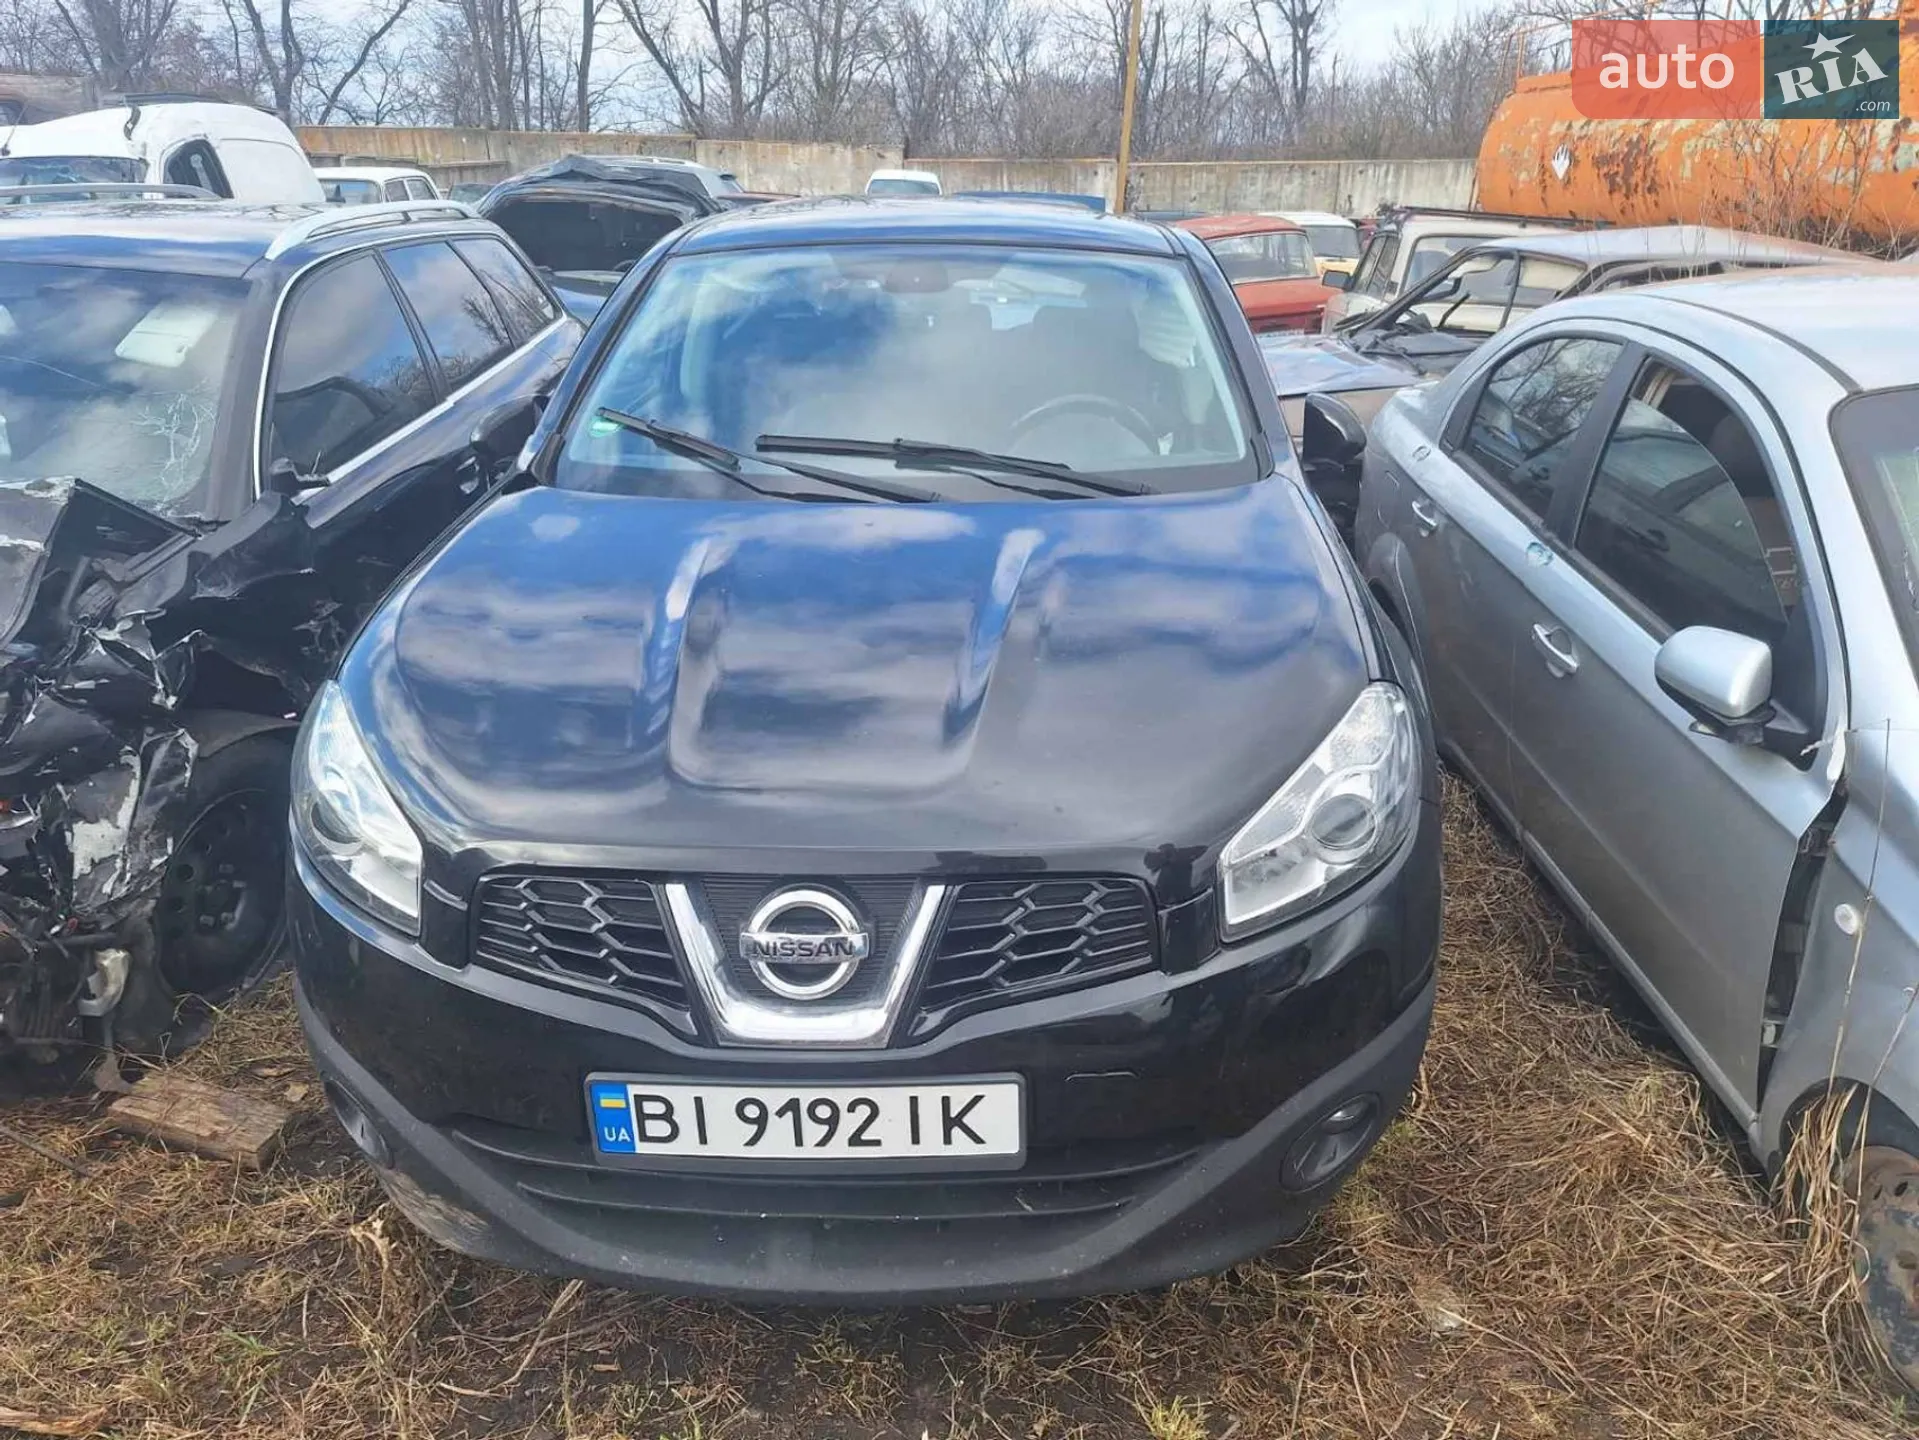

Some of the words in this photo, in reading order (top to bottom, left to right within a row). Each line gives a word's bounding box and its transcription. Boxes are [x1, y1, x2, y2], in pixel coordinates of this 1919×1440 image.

[750, 940, 854, 957] NISSAN
[634, 1094, 708, 1145] BI
[735, 1096, 882, 1147] 9192
[909, 1094, 986, 1146] IK
[604, 1126, 631, 1143] UA
